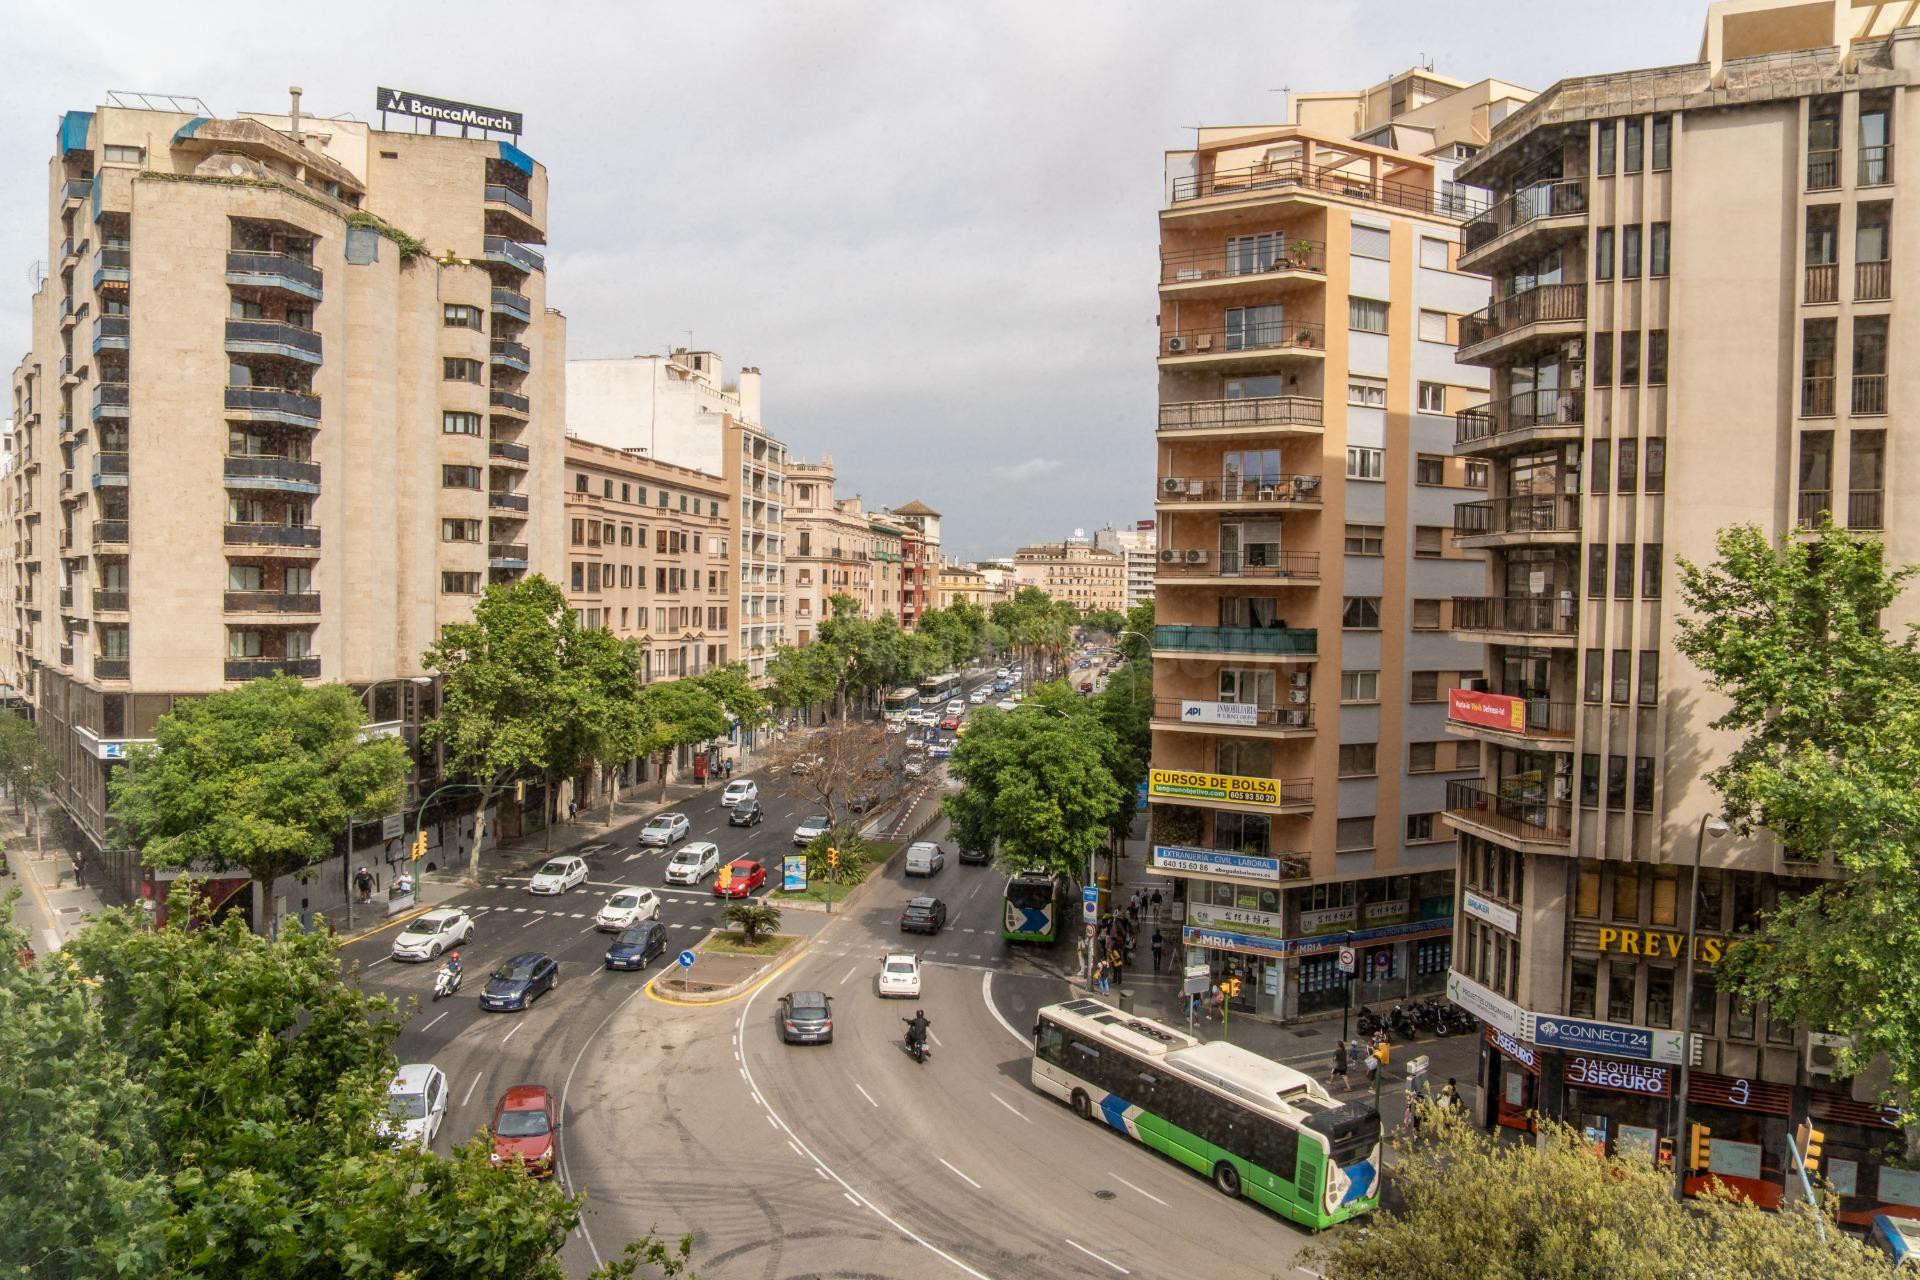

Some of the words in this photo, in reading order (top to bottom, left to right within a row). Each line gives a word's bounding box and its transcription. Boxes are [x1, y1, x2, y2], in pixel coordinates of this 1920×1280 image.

[411, 99, 512, 130] BancaMarch
[1185, 706, 1200, 716] API
[1217, 704, 1257, 715] INMOBILIARIA
[1154, 772, 1206, 787] CURSOS
[1211, 777, 1227, 788] DE
[1232, 779, 1276, 793] BOLSA
[1156, 785, 1225, 797] tengounobjetivo.com
[1245, 792, 1254, 800] 93
[1255, 793, 1264, 801] 50
[1265, 794, 1275, 802] 20
[1163, 860, 1176, 868] 640
[1179, 861, 1187, 869] 15
[1189, 862, 1197, 870] 60
[1214, 855, 1232, 865] CIVIL
[1238, 858, 1271, 869] LABORAL
[1560, 1024, 1629, 1043] CONNECT
[1630, 1033, 1648, 1046] 24
[1500, 1034, 1534, 1066] SEGURO
[1588, 1059, 1661, 1079] ALQUILER
[1588, 1070, 1662, 1093] SEGURO
